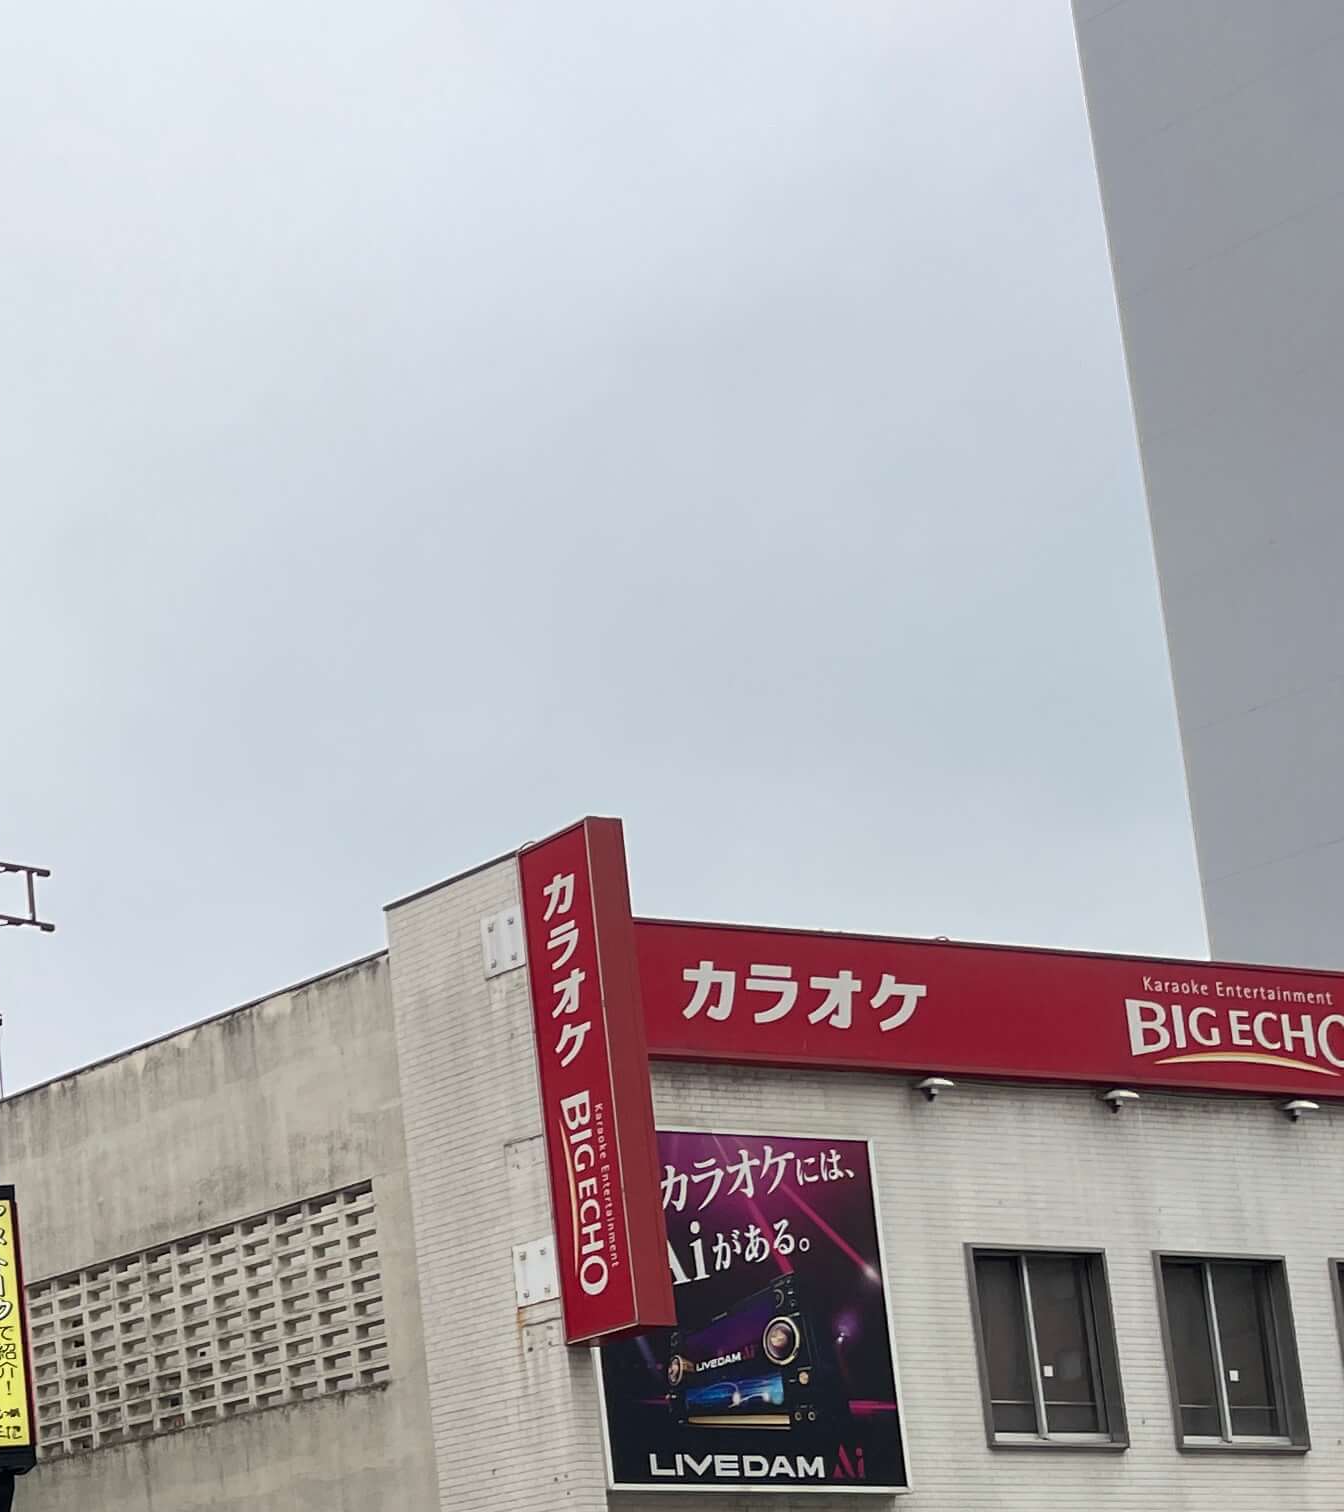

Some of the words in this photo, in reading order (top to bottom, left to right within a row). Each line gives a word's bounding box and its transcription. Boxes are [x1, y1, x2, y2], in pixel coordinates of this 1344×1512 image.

[542, 872, 593, 1068] カラオケ
[682, 960, 928, 1033] カラオケ
[1142, 976, 1209, 996] Karaoke
[1216, 981, 1334, 1006] Entertainment
[1124, 998, 1222, 1056] BIG
[560, 1090, 596, 1173] BIG
[593, 1103, 607, 1160] Karaoke
[600, 1163, 620, 1268] Entertainment
[577, 1176, 609, 1296] ECHO
[695, 1351, 742, 1373] LIVEDAM
[649, 1453, 826, 1479] LIVEDAM
